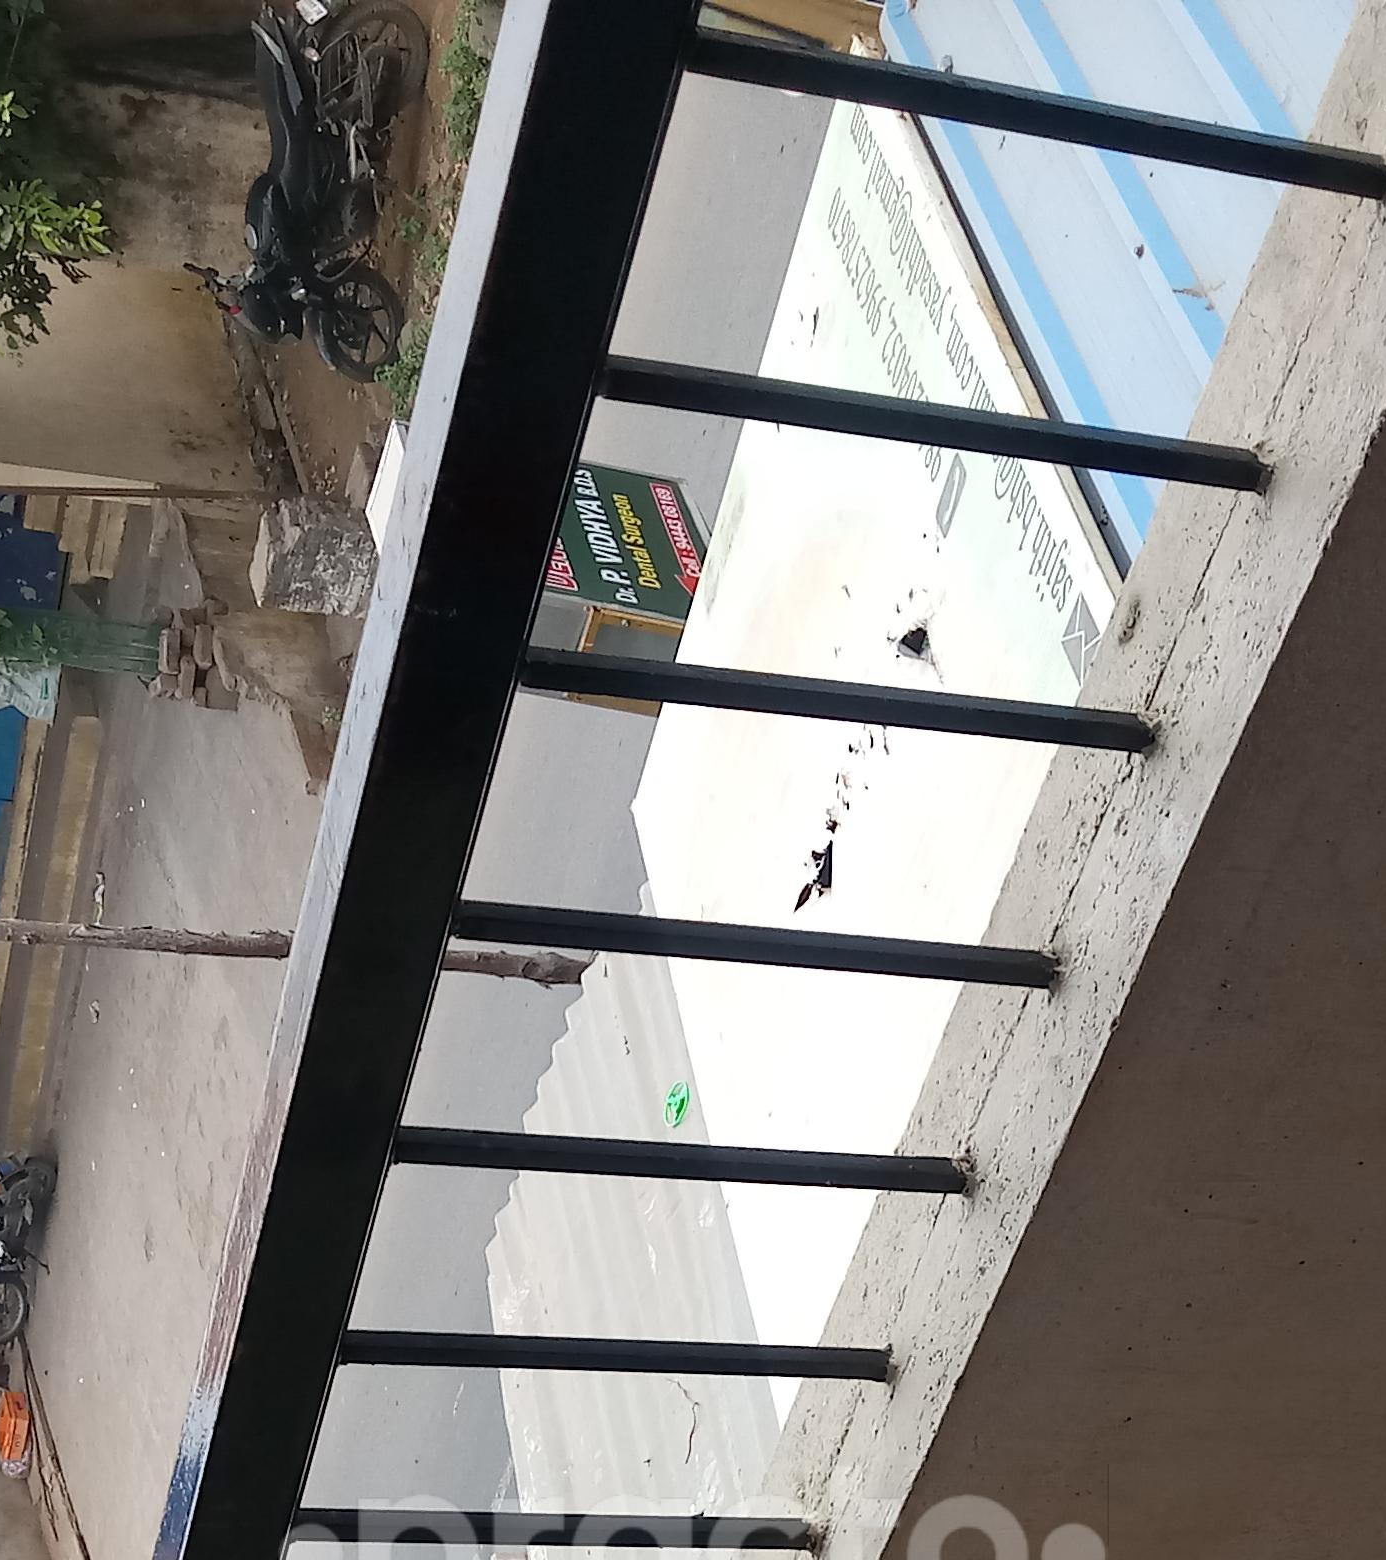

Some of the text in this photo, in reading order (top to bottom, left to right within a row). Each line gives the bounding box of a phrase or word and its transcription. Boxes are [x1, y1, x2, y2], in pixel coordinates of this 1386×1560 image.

[574, 469, 639, 605] Dr. P. VIDHYA B.D.S
[613, 493, 661, 589] Dental Surgeon
[681, 557, 701, 577] Cell
